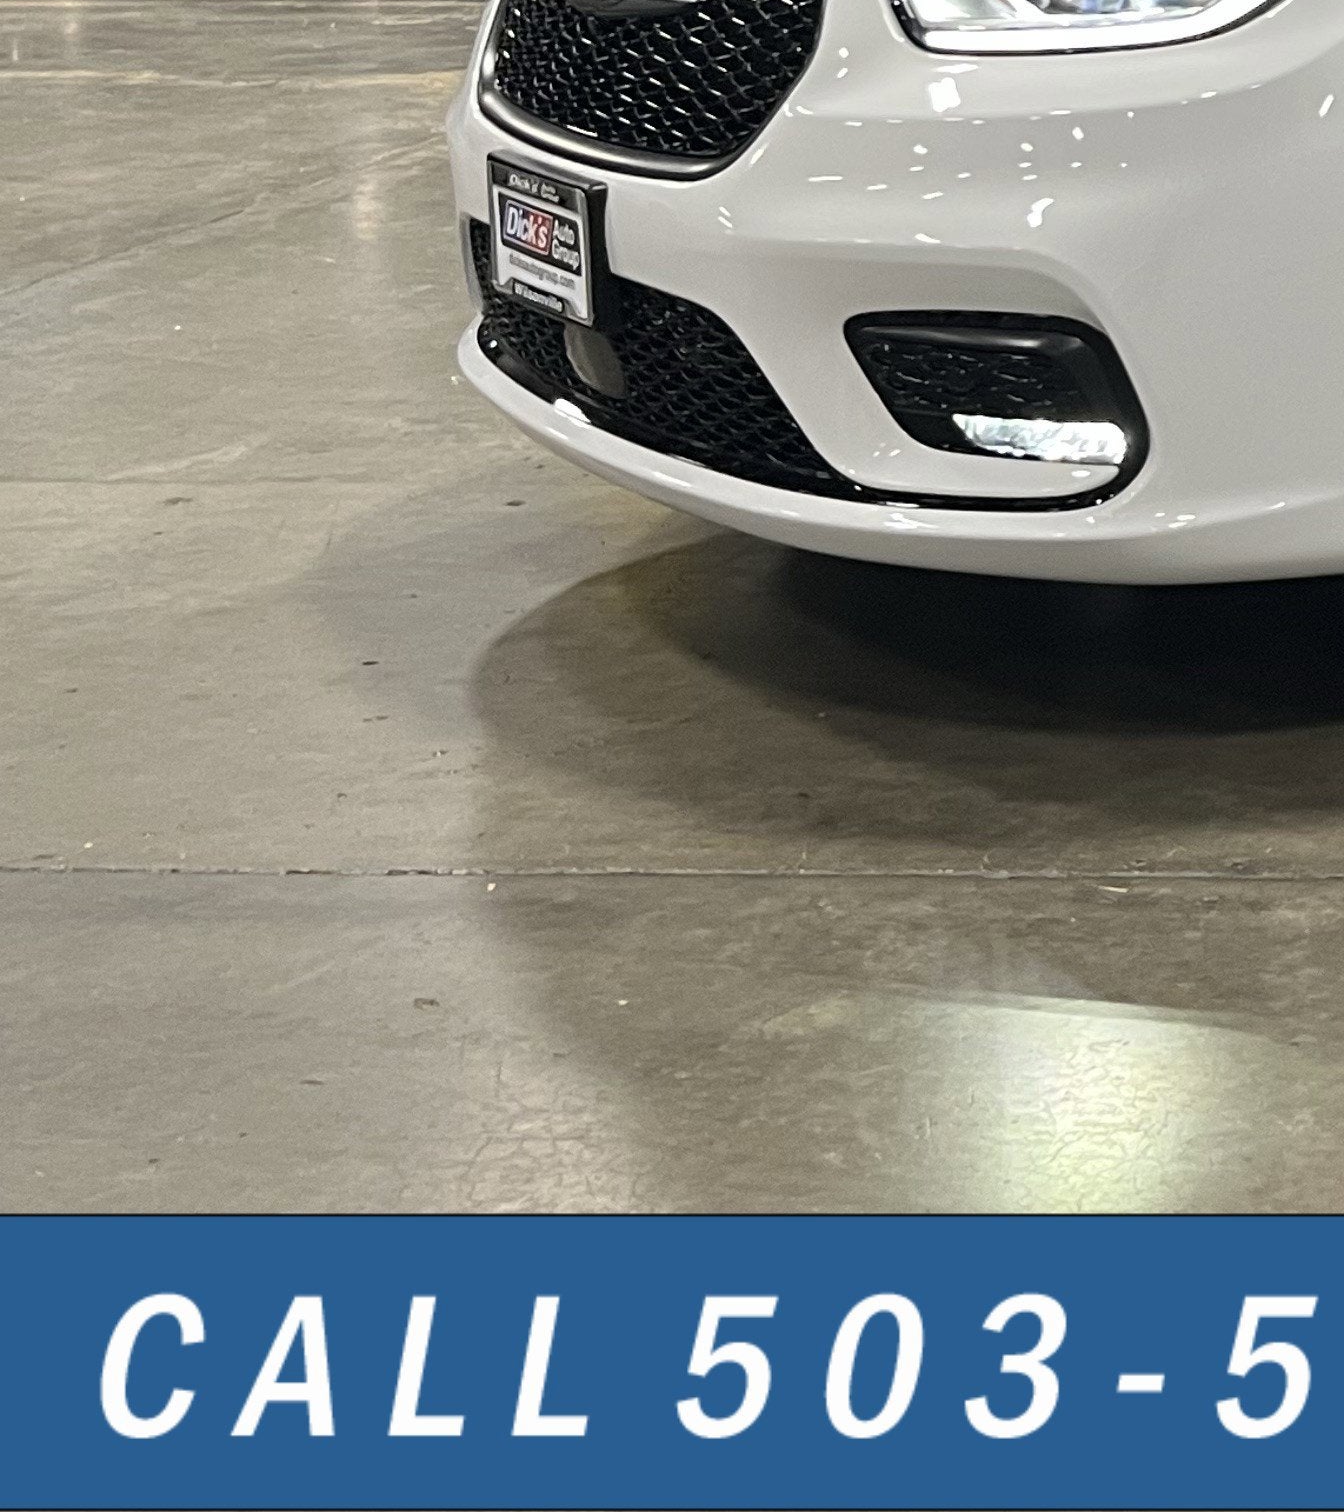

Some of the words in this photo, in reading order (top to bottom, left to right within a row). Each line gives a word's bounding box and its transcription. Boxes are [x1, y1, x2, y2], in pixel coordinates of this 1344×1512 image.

[505, 205, 549, 249] Dick's
[553, 218, 575, 246] Auto
[551, 238, 580, 272] Group
